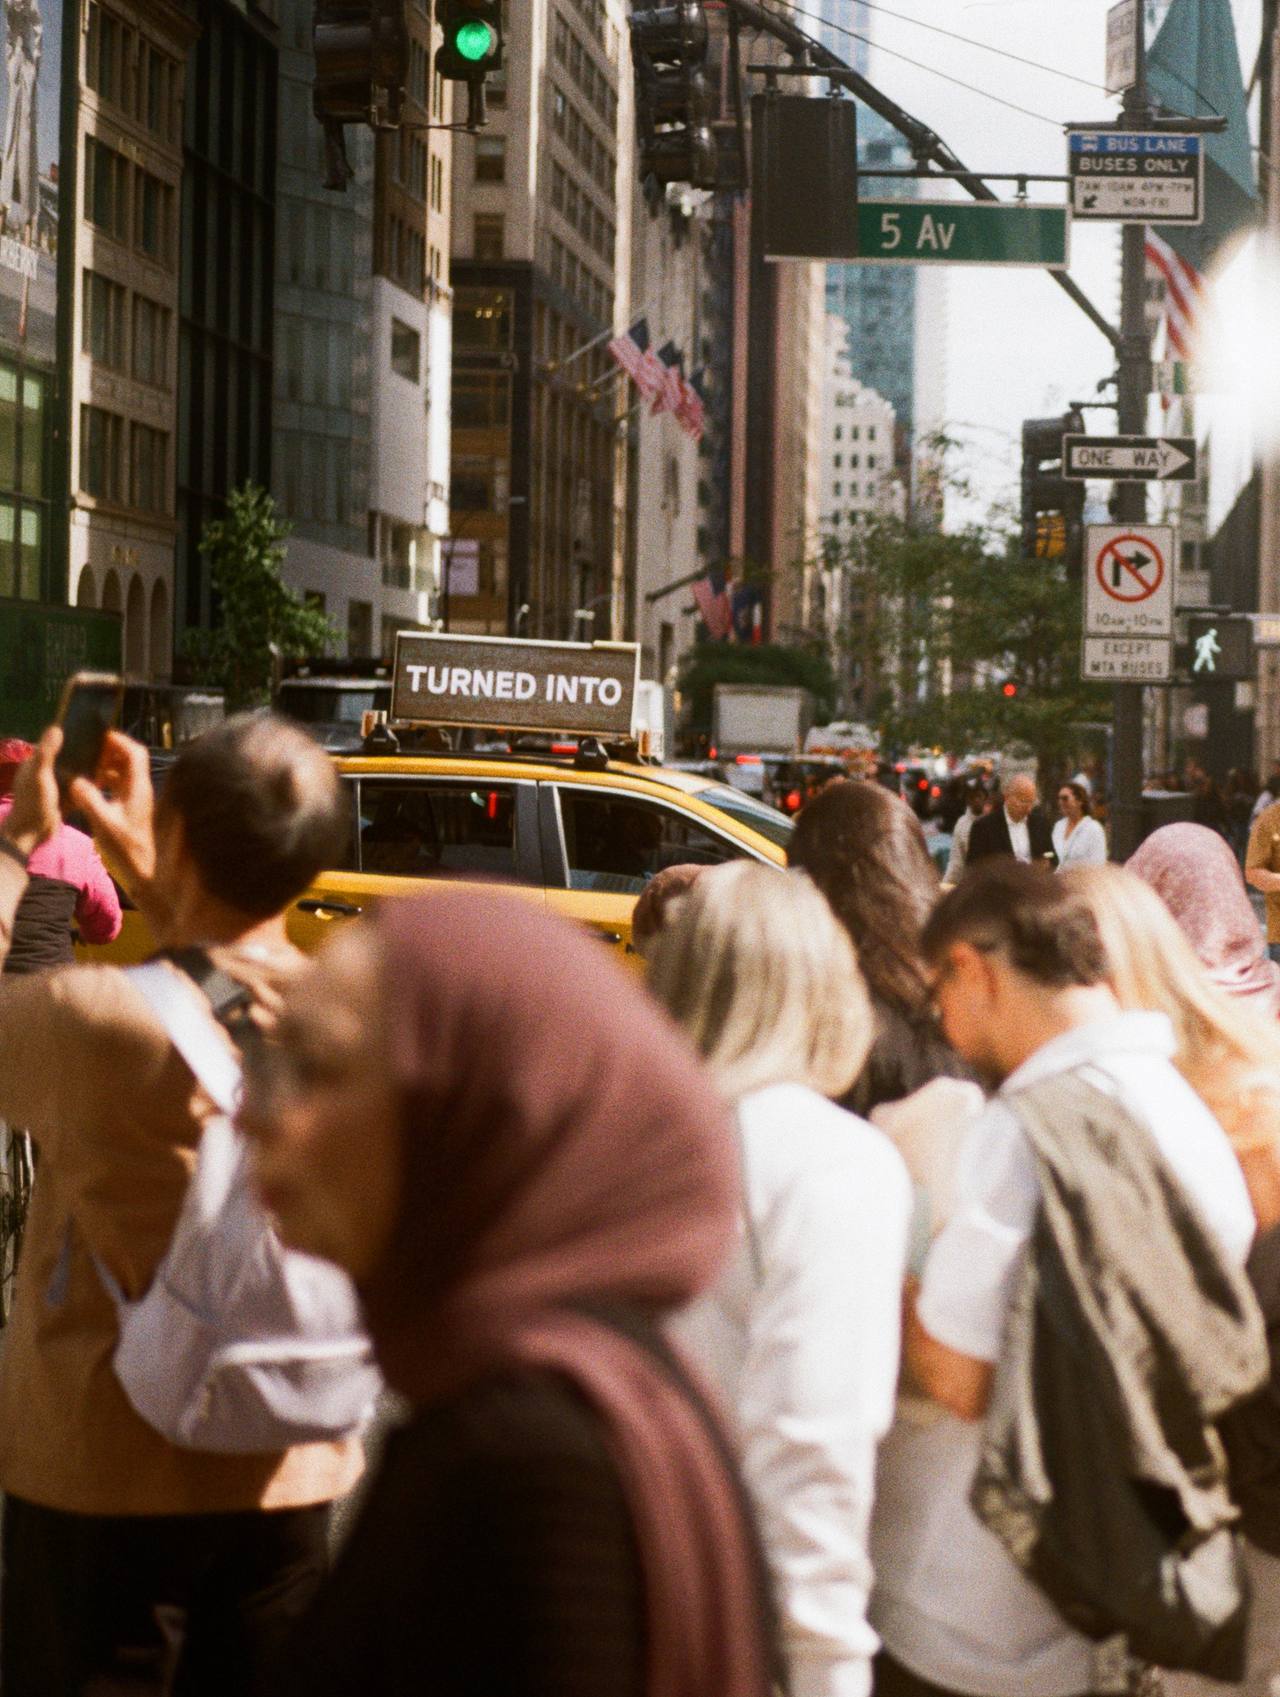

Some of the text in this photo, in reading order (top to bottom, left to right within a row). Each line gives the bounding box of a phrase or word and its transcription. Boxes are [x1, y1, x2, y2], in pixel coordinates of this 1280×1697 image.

[1106, 138, 1188, 153] BUS LANE
[1079, 157, 1190, 173] BUSES ONLY
[880, 212, 956, 250] 5 Av
[1078, 447, 1171, 467] ONE WAY
[1103, 641, 1151, 655] EXCEPT
[1091, 661, 1162, 674] MTA BUSES
[406, 664, 622, 706] TURNED INTO
